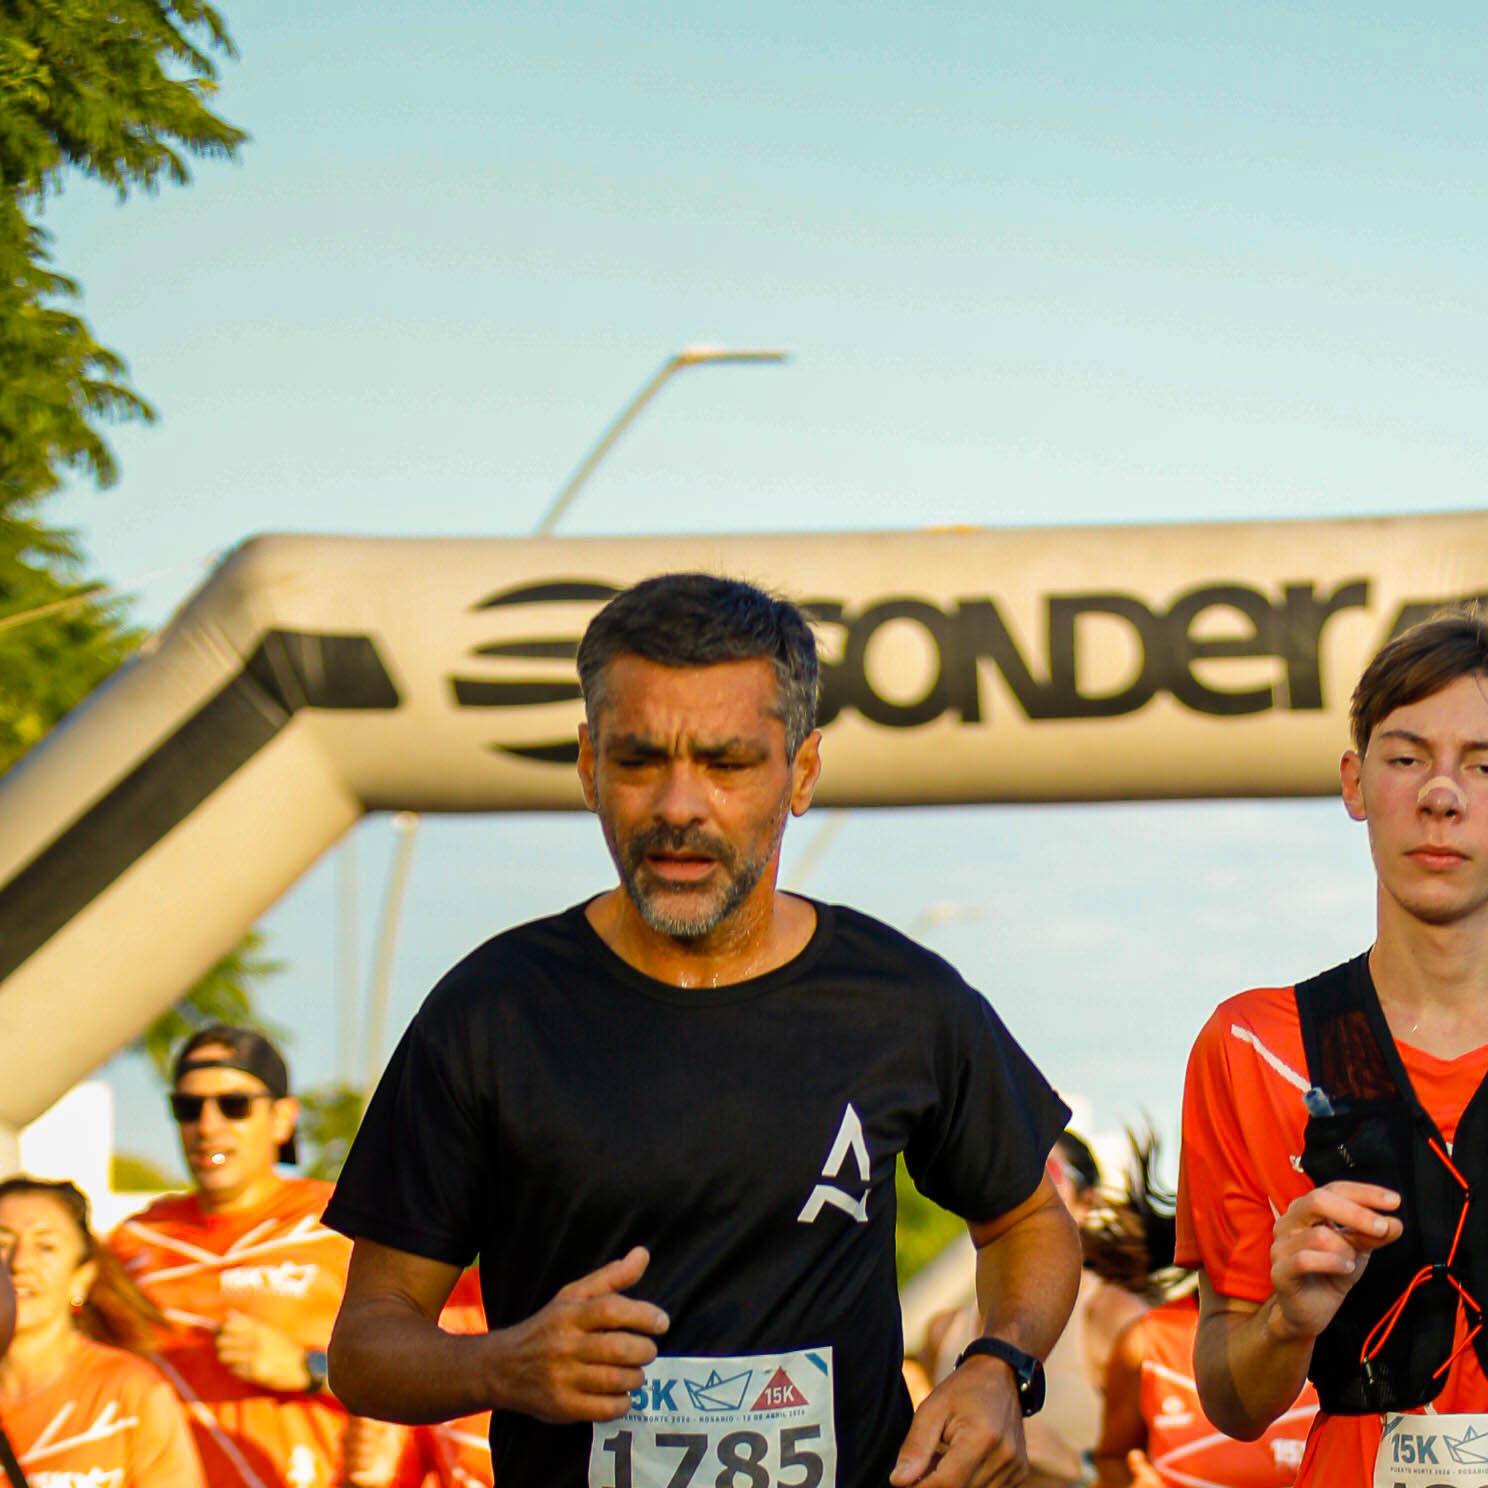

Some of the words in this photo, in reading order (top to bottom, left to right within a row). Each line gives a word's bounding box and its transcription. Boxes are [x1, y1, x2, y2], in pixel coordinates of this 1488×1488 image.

[629, 1379, 678, 1412] 5K
[764, 1384, 794, 1405] 15K
[1391, 1433, 1440, 1465] 15K
